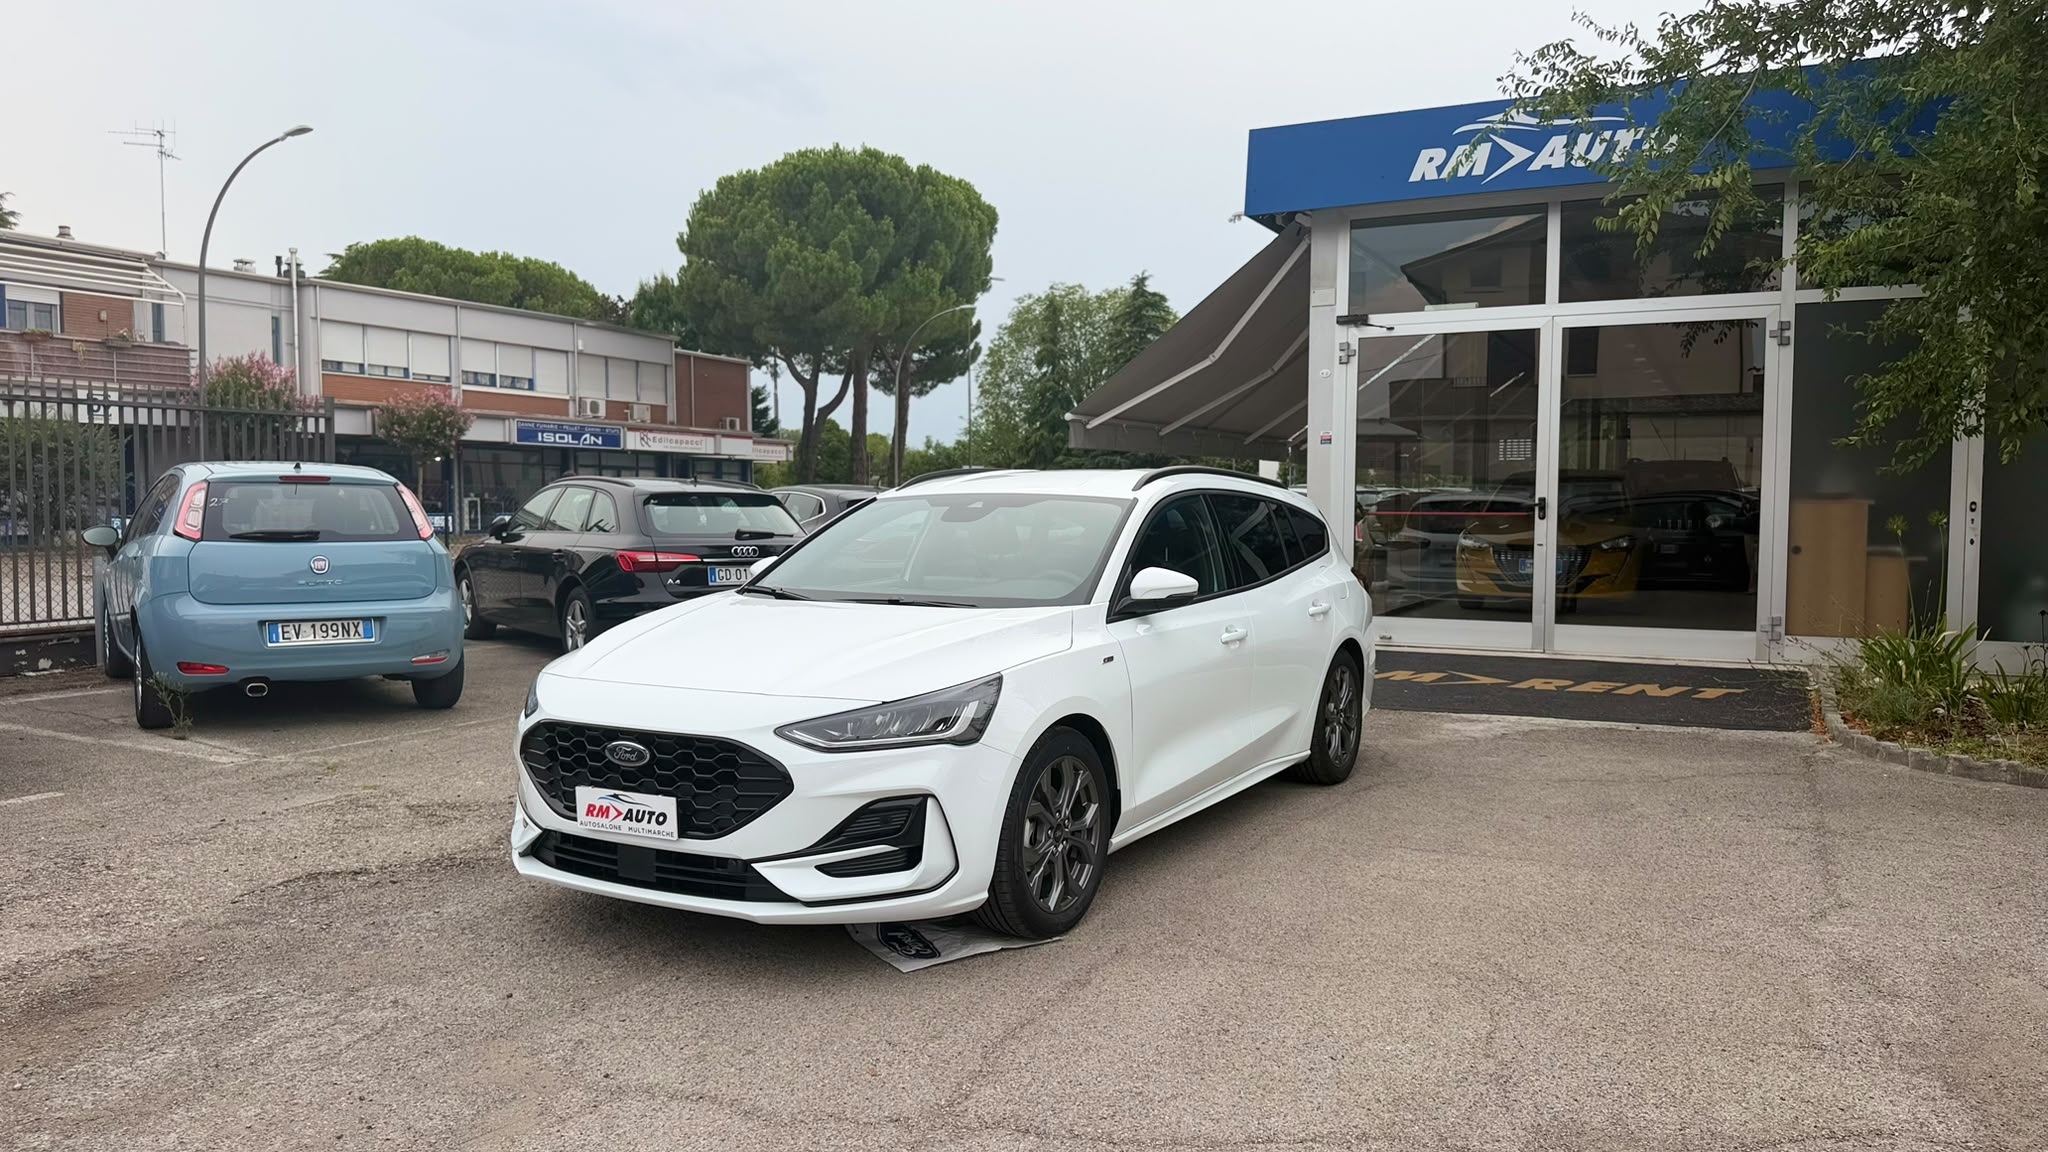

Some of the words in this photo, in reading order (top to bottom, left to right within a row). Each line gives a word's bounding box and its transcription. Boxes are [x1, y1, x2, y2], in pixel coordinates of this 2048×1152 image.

[1408, 142, 1493, 183] RM
[537, 432, 602, 446] ISOLAN
[717, 568, 731, 581] GD
[735, 567, 753, 582] 01
[281, 623, 302, 640] EV
[310, 621, 362, 639] 199NX
[1507, 678, 1746, 698] RENT
[613, 745, 638, 761] Ford
[585, 803, 611, 819] RM
[622, 808, 668, 826] AUTO
[580, 821, 622, 831] AUTOSALONE
[628, 826, 675, 838] MULTIMARCHE
